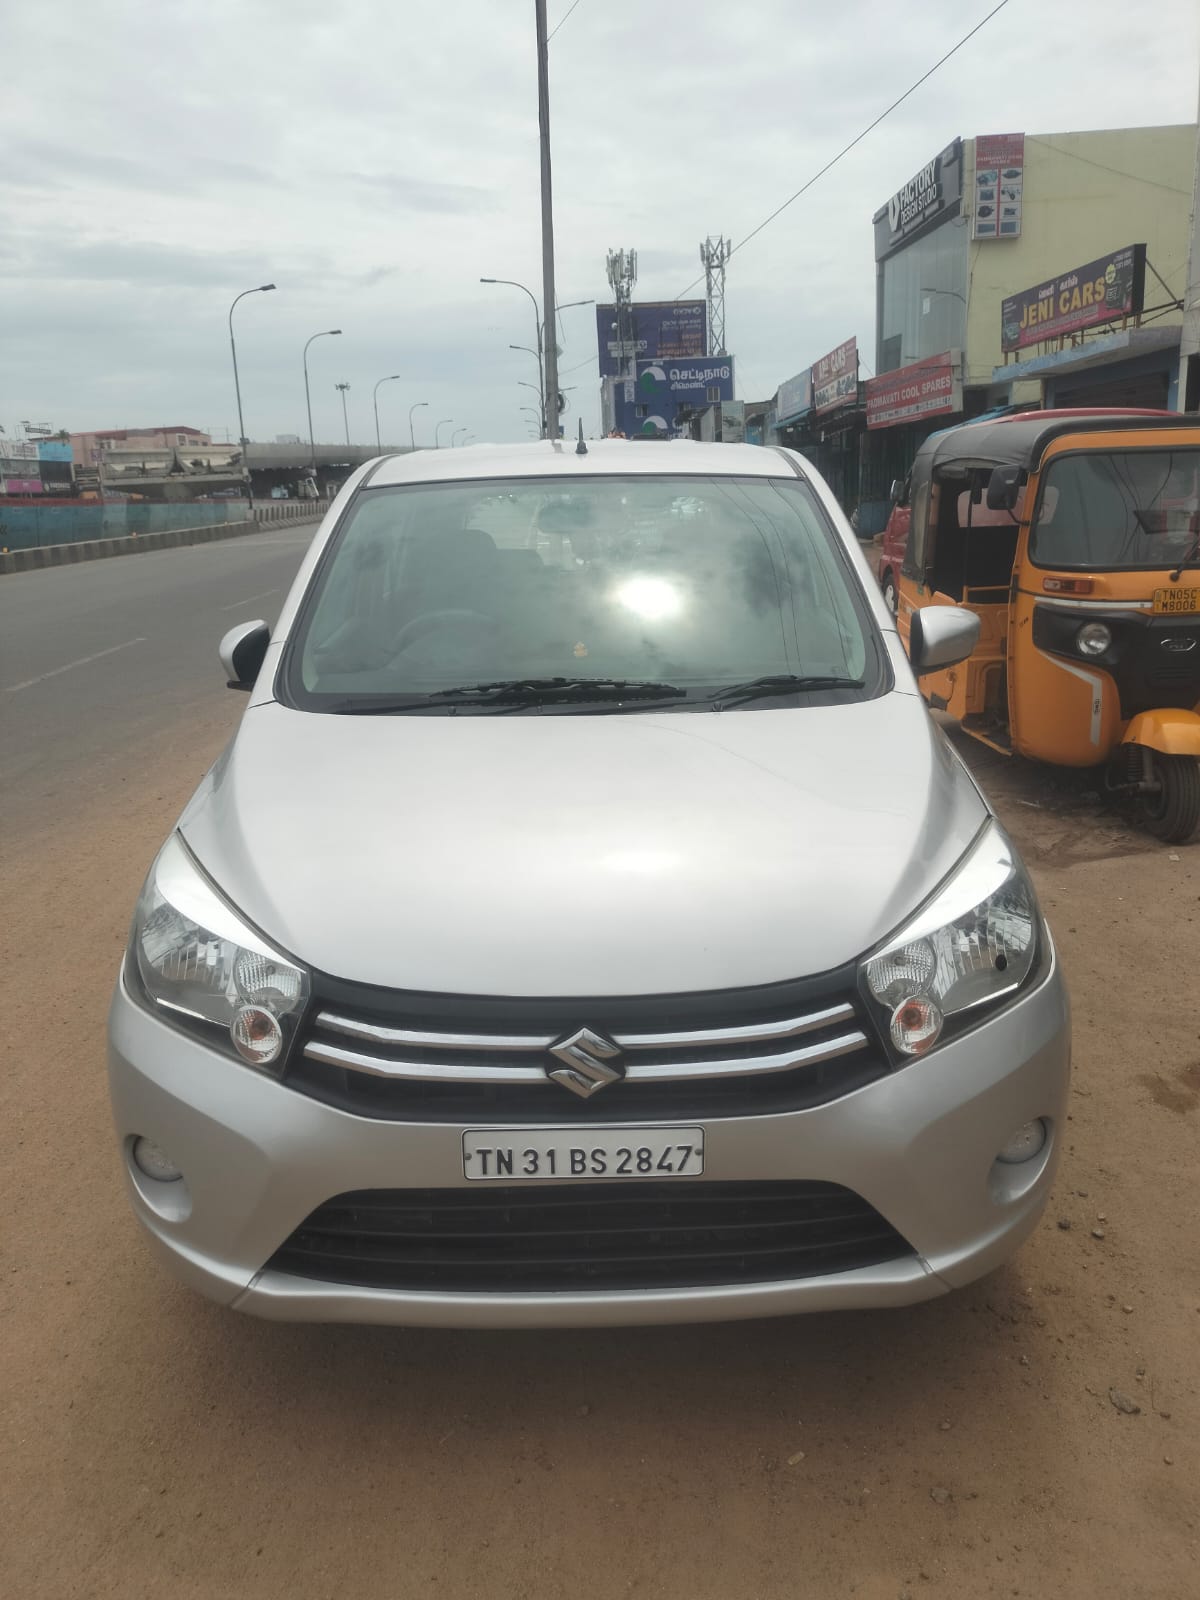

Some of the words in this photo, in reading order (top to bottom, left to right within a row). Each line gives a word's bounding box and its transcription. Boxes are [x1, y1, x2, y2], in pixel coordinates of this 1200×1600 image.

[900, 159, 936, 209] FACTORY
[900, 202, 919, 225] DESIGN
[1019, 296, 1054, 329] JENI
[1058, 276, 1105, 314] CARS
[669, 366, 730, 382] செட்டிநாடு
[867, 391, 900, 409] PADMAVATI
[901, 384, 920, 401] COOL
[921, 375, 951, 394] SPARES
